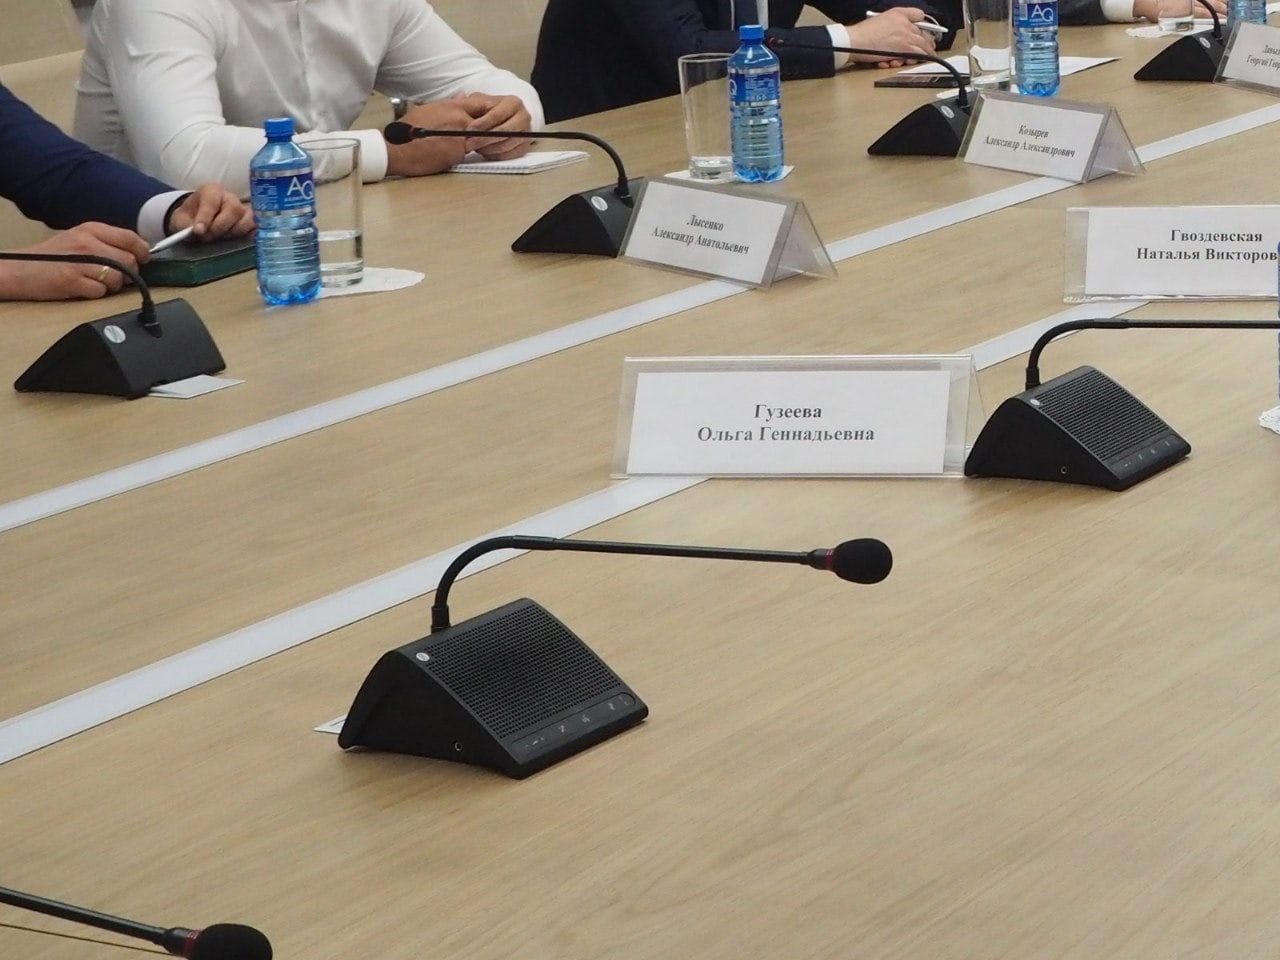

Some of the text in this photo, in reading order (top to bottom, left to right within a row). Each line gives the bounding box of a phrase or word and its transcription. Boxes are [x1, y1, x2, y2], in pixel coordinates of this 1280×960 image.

[1018, 124, 1049, 139] Козырев
[984, 135, 1076, 158] Александр Александрович
[686, 214, 724, 232] Лысенко
[651, 227, 750, 255] Александр Анатольевич
[1170, 229, 1263, 243] Гвоздевская
[1136, 247, 1278, 264] Наталья Викторов
[754, 404, 822, 422] Гузеева
[697, 426, 875, 442] Ольга Геннадьевна
